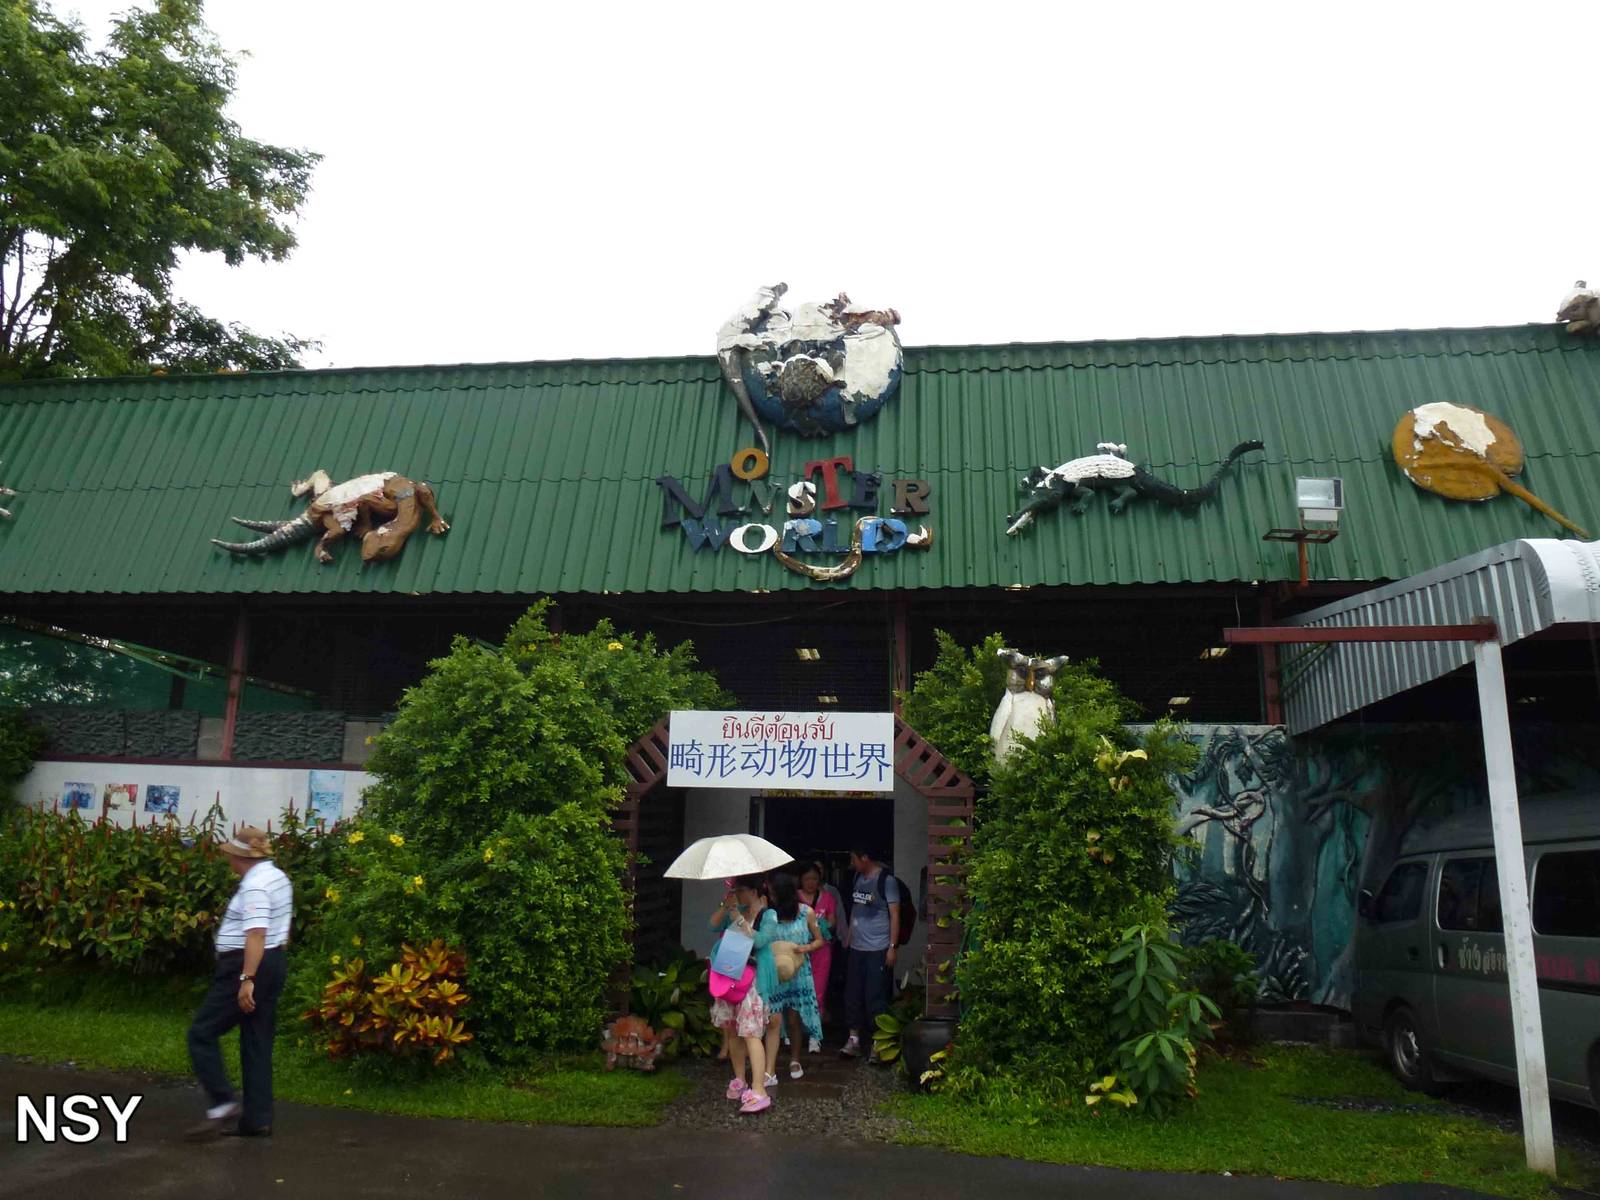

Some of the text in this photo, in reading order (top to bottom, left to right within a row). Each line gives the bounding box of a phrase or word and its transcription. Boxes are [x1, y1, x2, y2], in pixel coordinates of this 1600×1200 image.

[656, 447, 931, 528] MONSTER
[681, 514, 909, 554] WORLD
[722, 713, 835, 743] ยินดีต้อนรับ
[670, 739, 893, 782] 畸形动物世界
